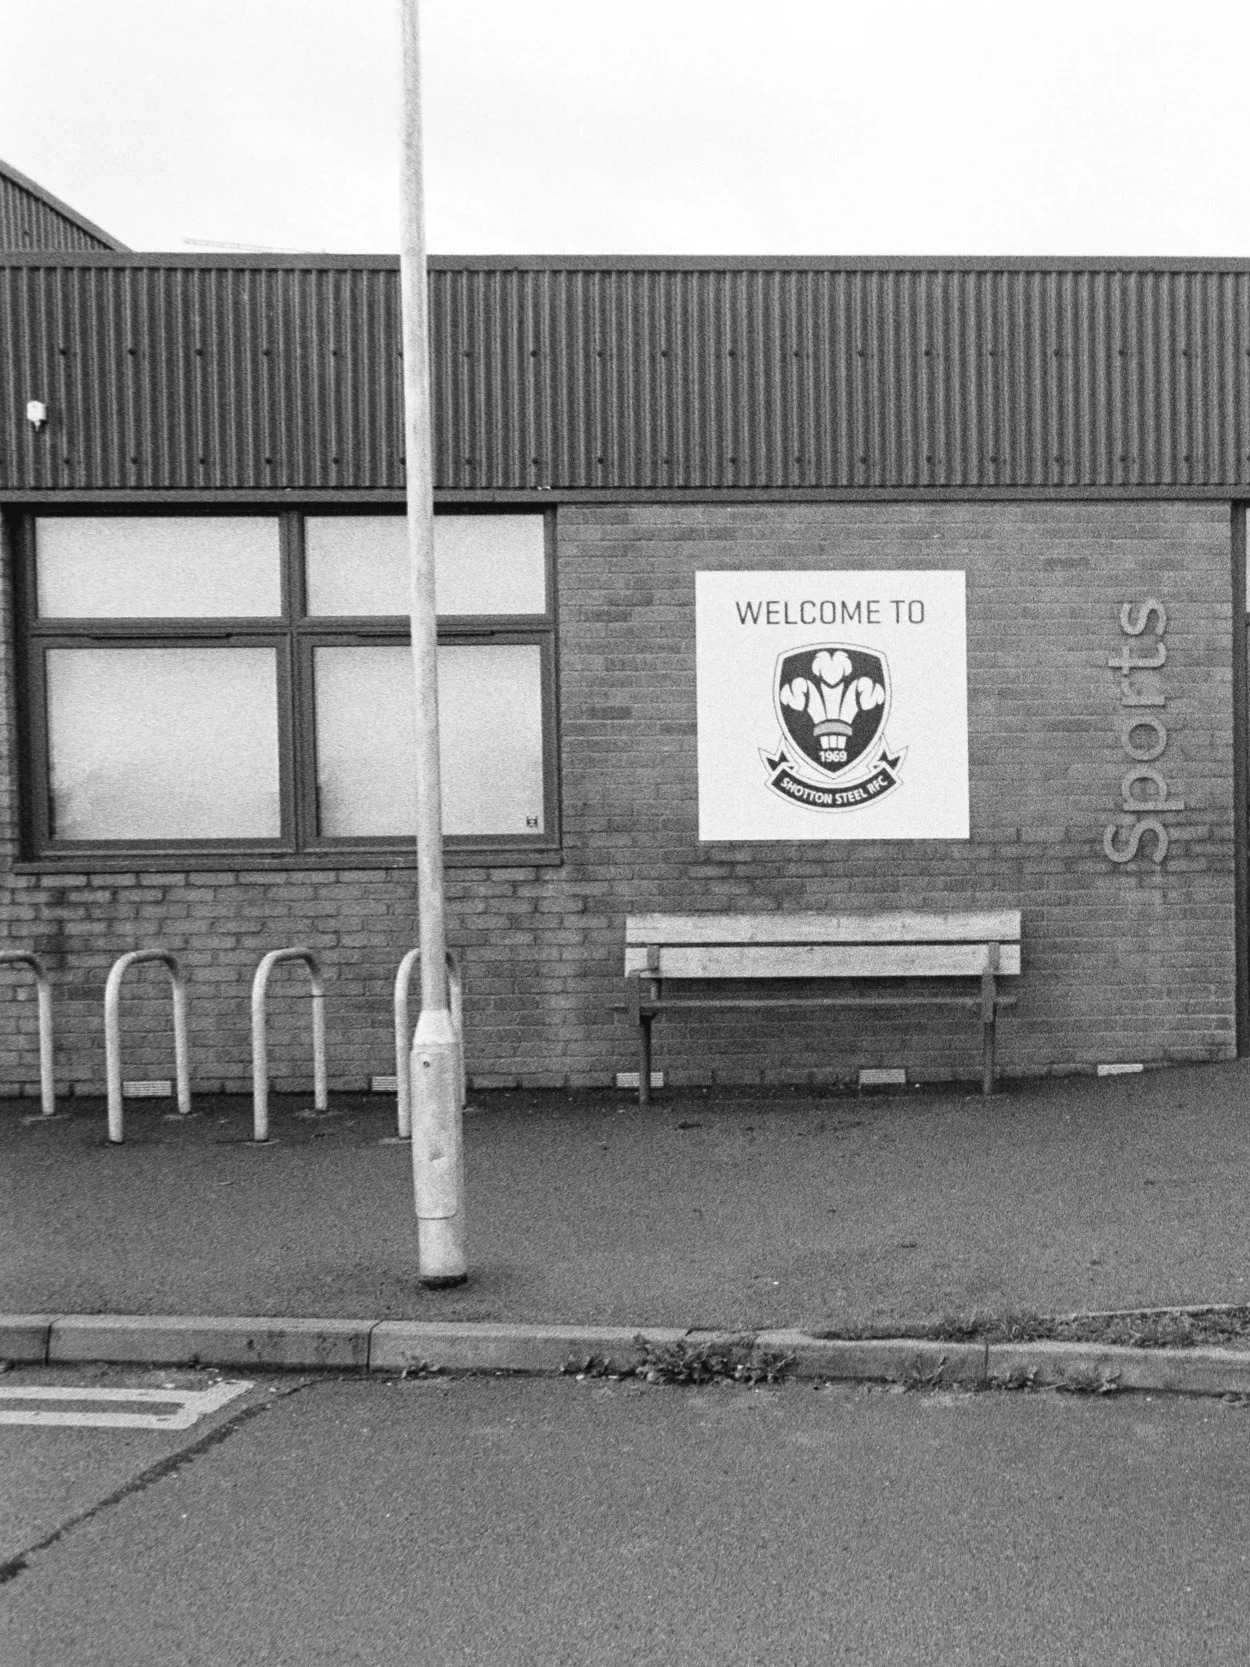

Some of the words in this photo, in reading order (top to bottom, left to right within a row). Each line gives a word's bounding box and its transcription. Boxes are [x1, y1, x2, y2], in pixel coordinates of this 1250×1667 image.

[735, 600, 881, 625] WELCOME
[890, 600, 925, 625] TO
[1103, 599, 1184, 863] Sports
[819, 750, 847, 762] 1969
[780, 777, 833, 804] SHOTTON
[834, 788, 868, 804] STEEL
[866, 775, 888, 794] RFC
